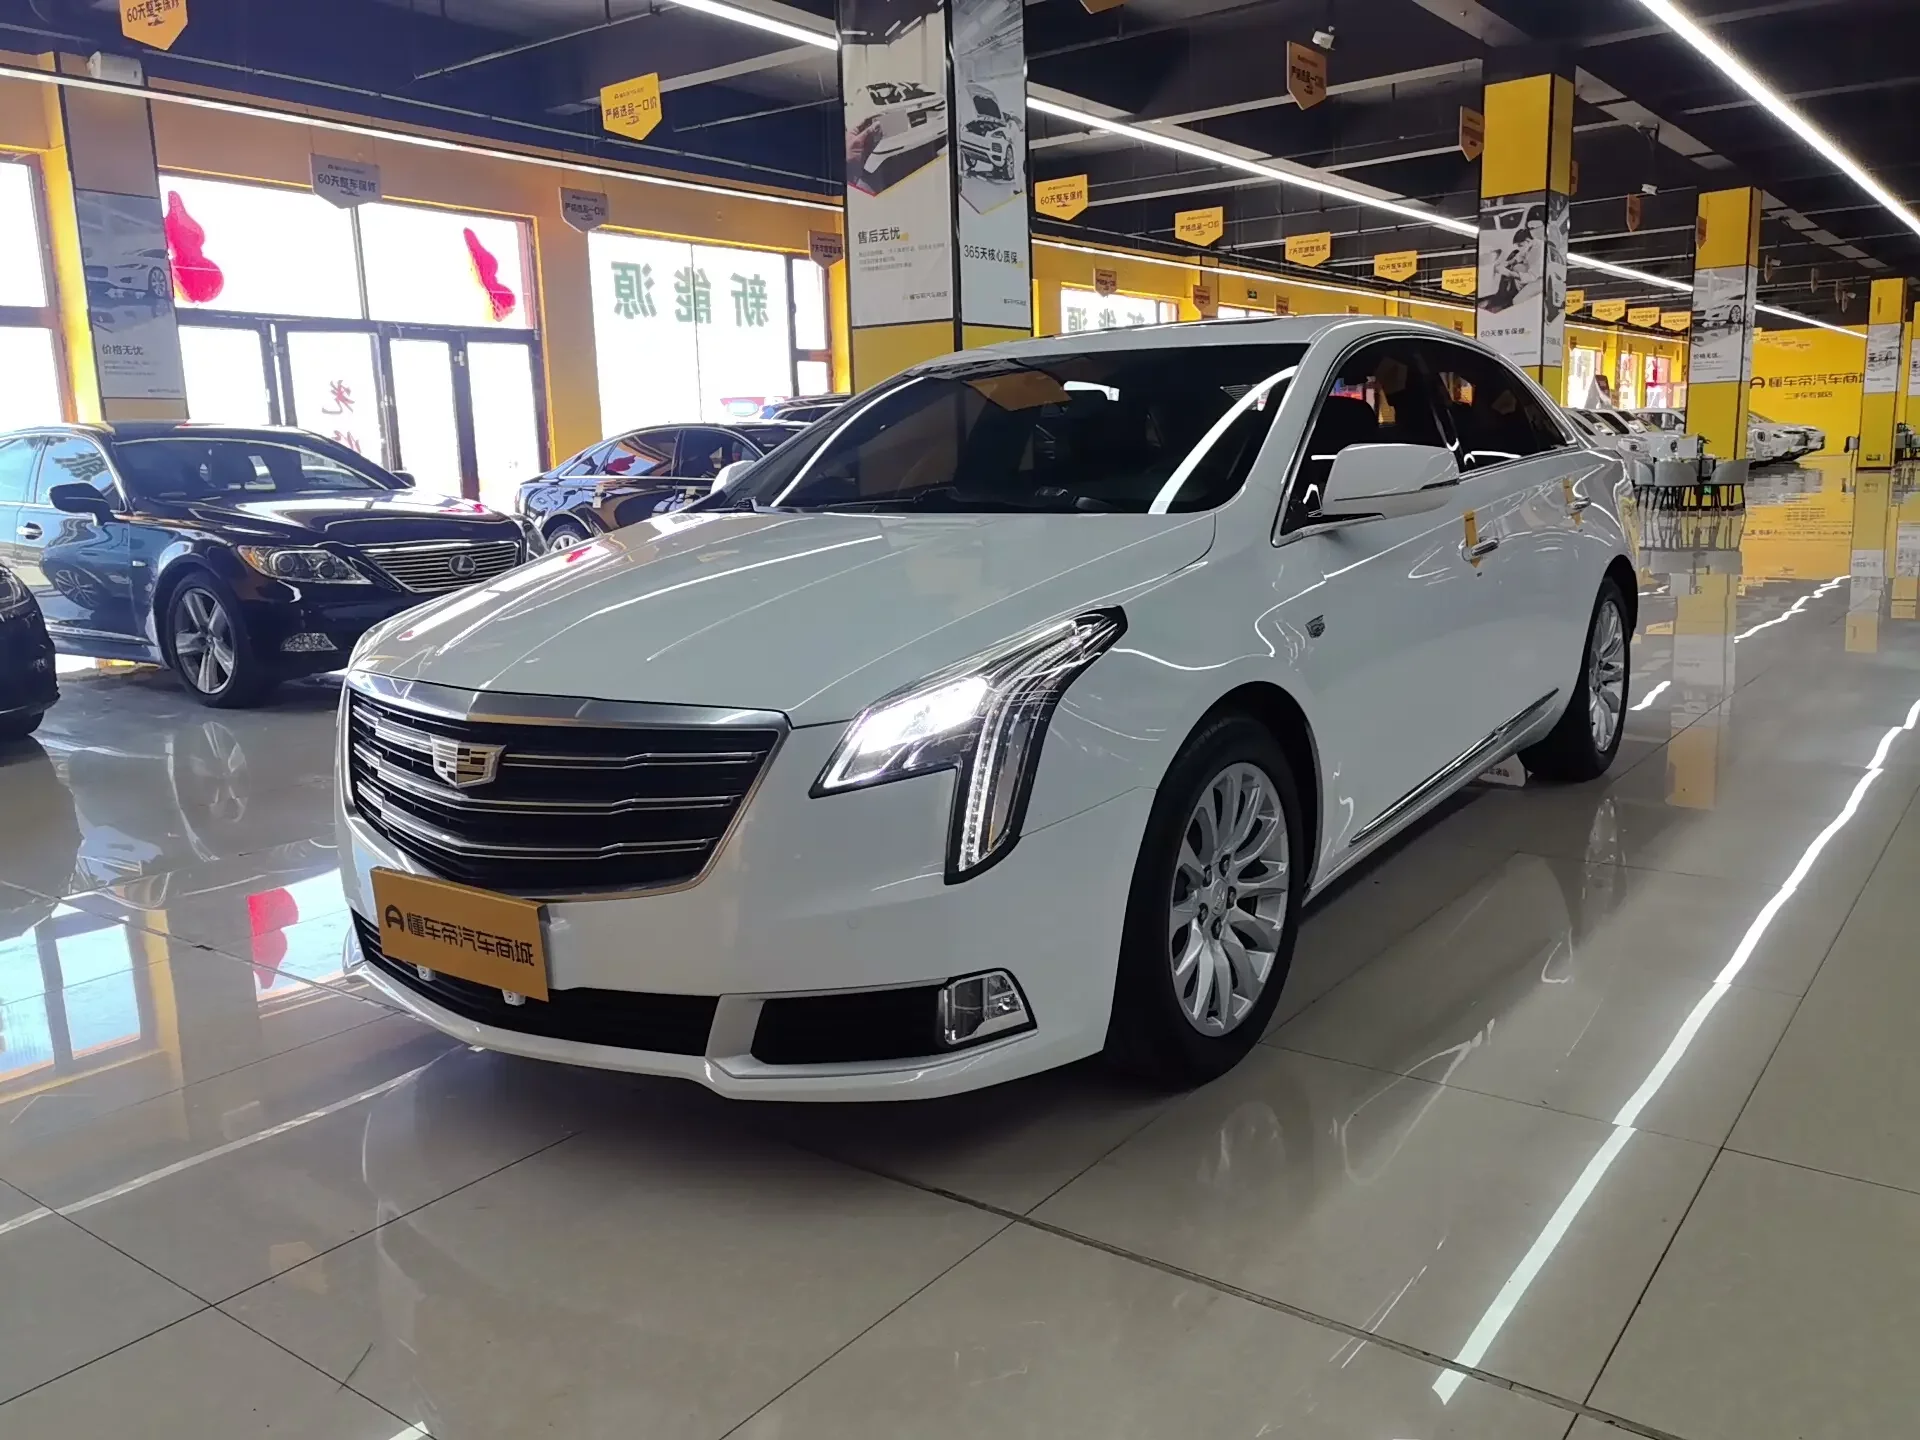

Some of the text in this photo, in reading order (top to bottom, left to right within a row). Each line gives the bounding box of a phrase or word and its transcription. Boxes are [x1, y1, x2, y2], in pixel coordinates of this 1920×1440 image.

[857, 226, 901, 244] 售后无忧
[963, 244, 1018, 264] 365天核心质保
[102, 343, 144, 356] 价格无忧
[406, 911, 535, 967] 懂车帝汽车商城
